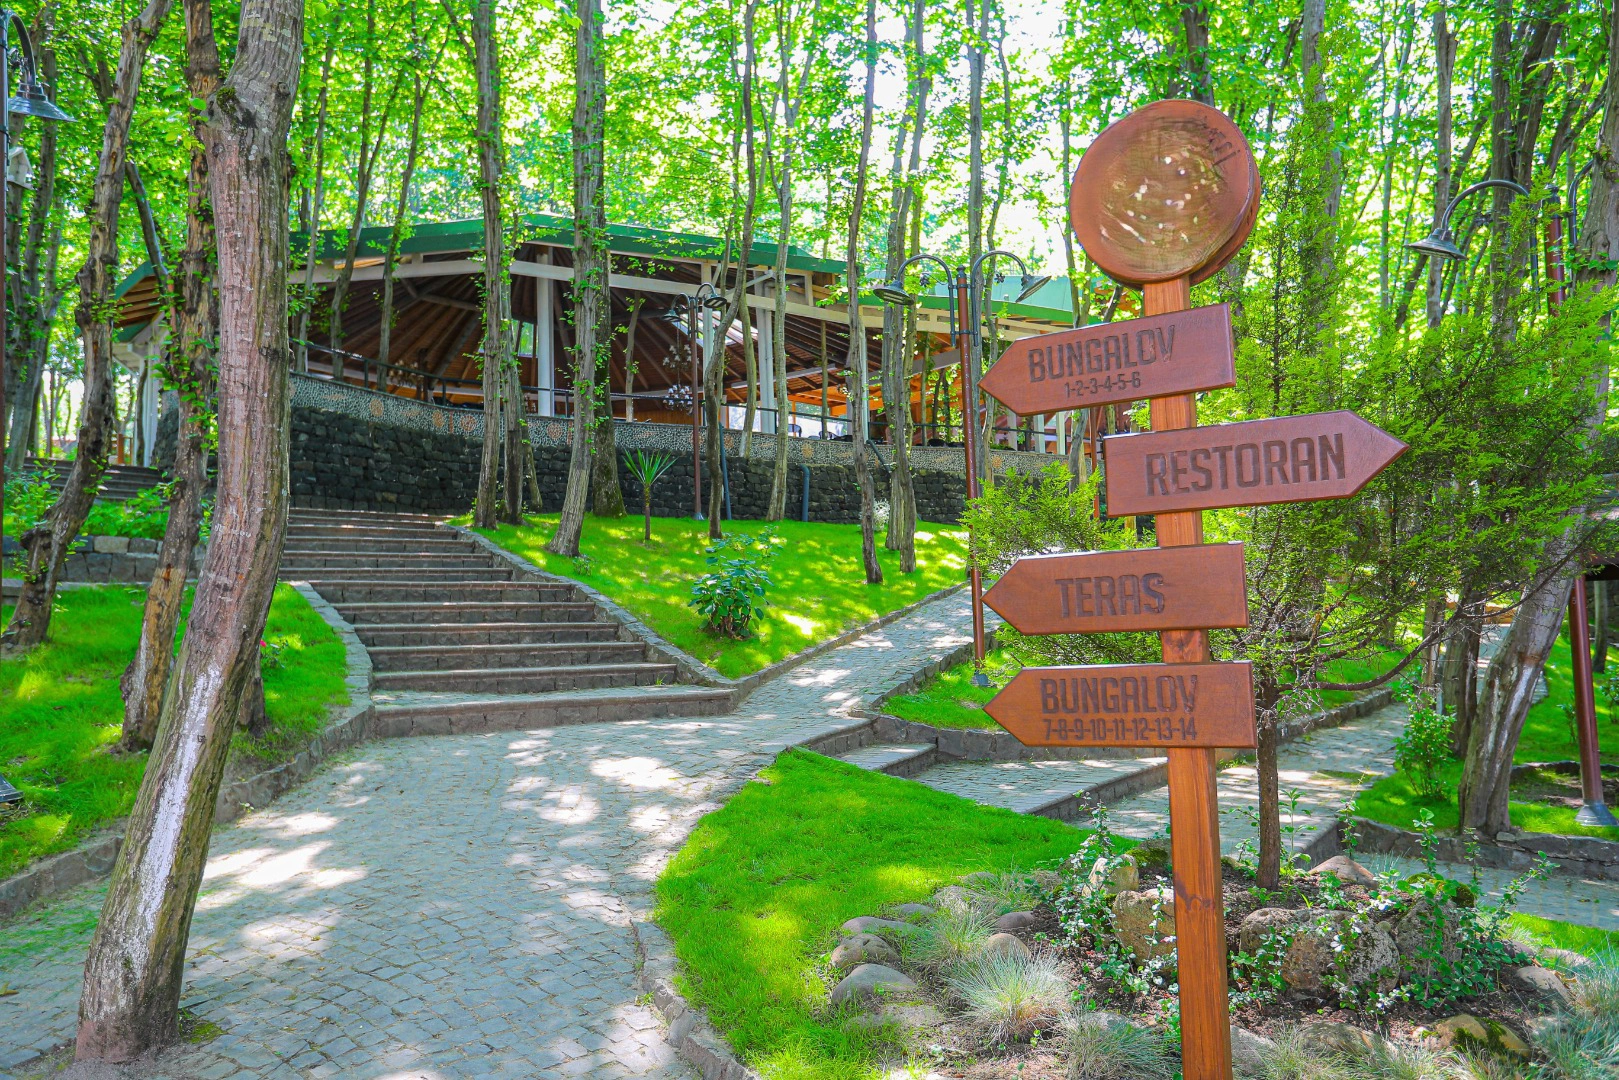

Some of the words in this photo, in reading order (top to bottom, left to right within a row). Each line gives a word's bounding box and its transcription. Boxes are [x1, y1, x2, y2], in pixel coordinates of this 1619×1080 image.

[1027, 324, 1176, 384] BUNGALOV
[1064, 371, 1141, 398] 1-2-3-4-5-6
[1145, 433, 1346, 497] RESTORAN
[1055, 572, 1165, 618] TERAS
[1040, 675, 1198, 714] BUNGALOV
[1042, 717, 1198, 741] 7-8-9-10-11-12-13-14
